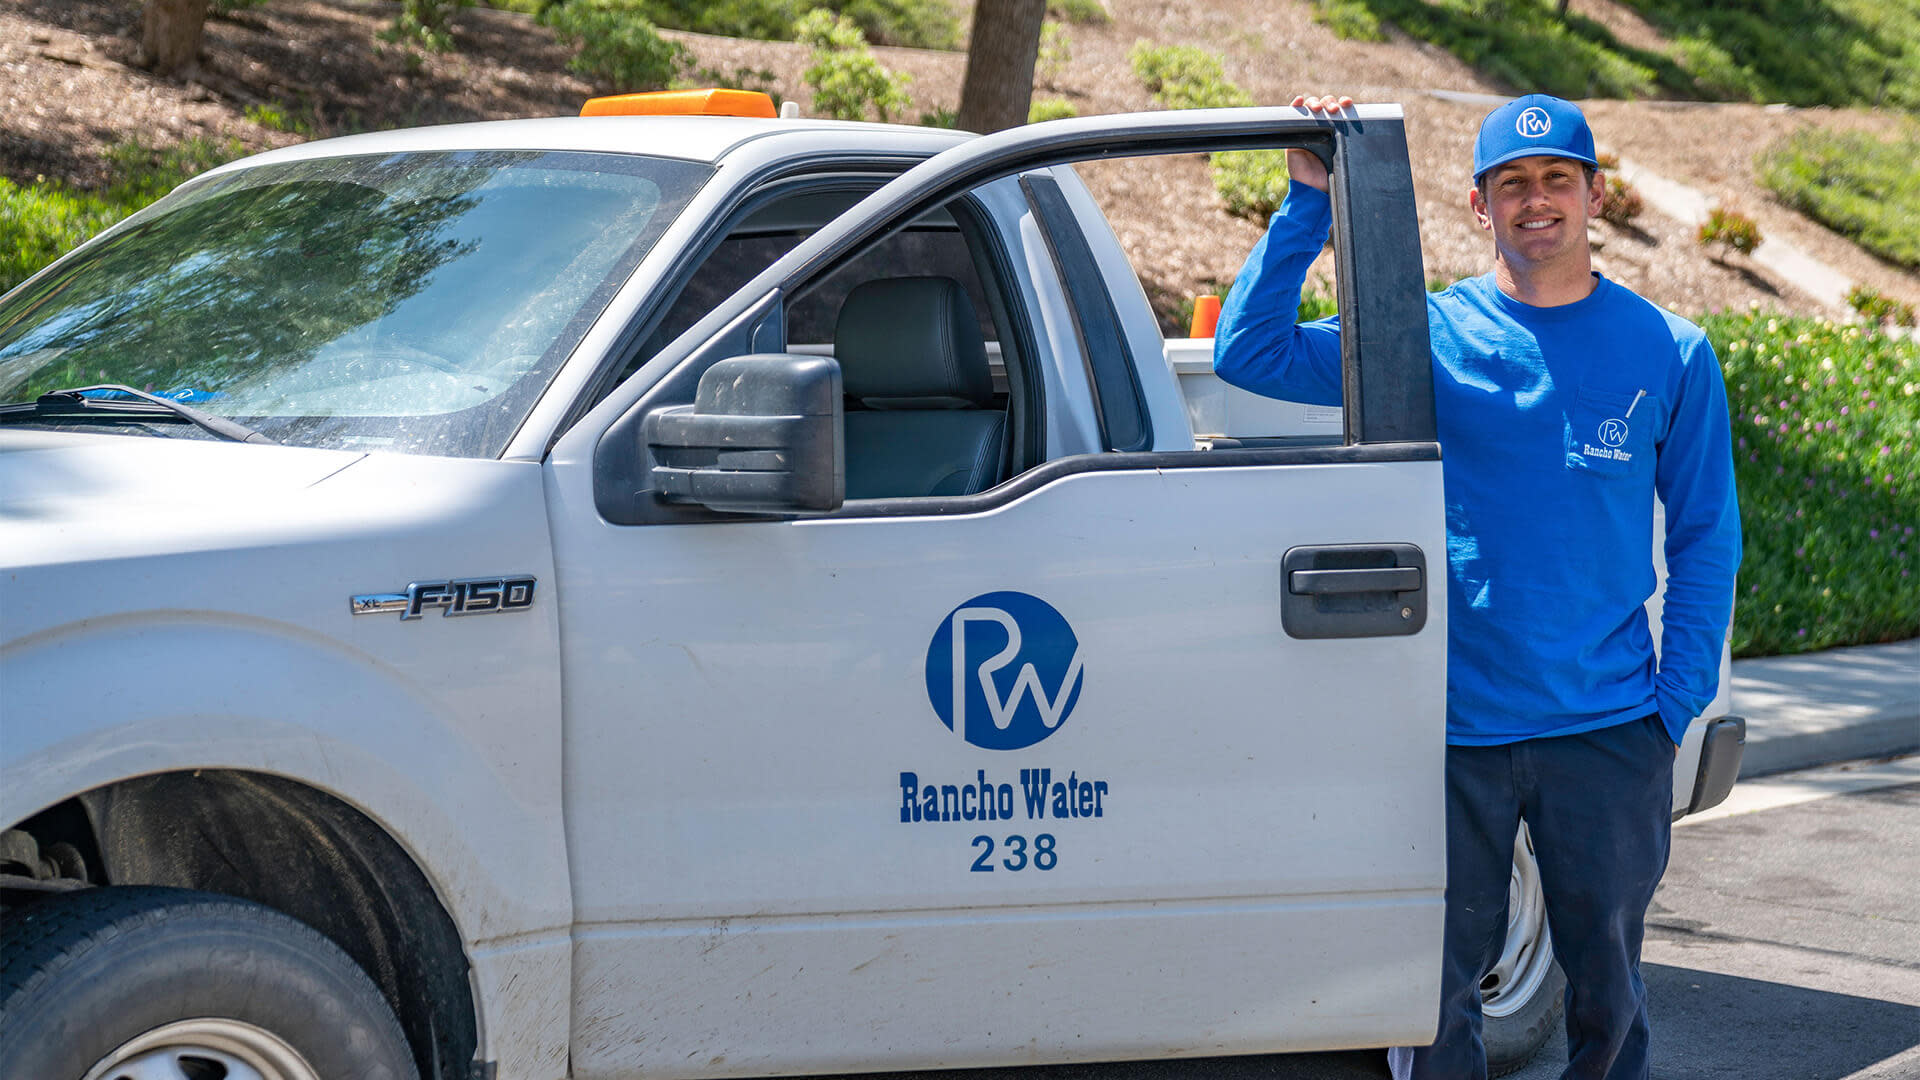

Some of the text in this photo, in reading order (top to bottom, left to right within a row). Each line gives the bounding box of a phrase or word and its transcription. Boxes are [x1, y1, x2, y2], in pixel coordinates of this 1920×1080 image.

[1583, 444, 1632, 461] Rancho Water
[361, 575, 537, 620] XL F-150
[899, 768, 1108, 823] Rancho Water
[970, 833, 1058, 872] 238
